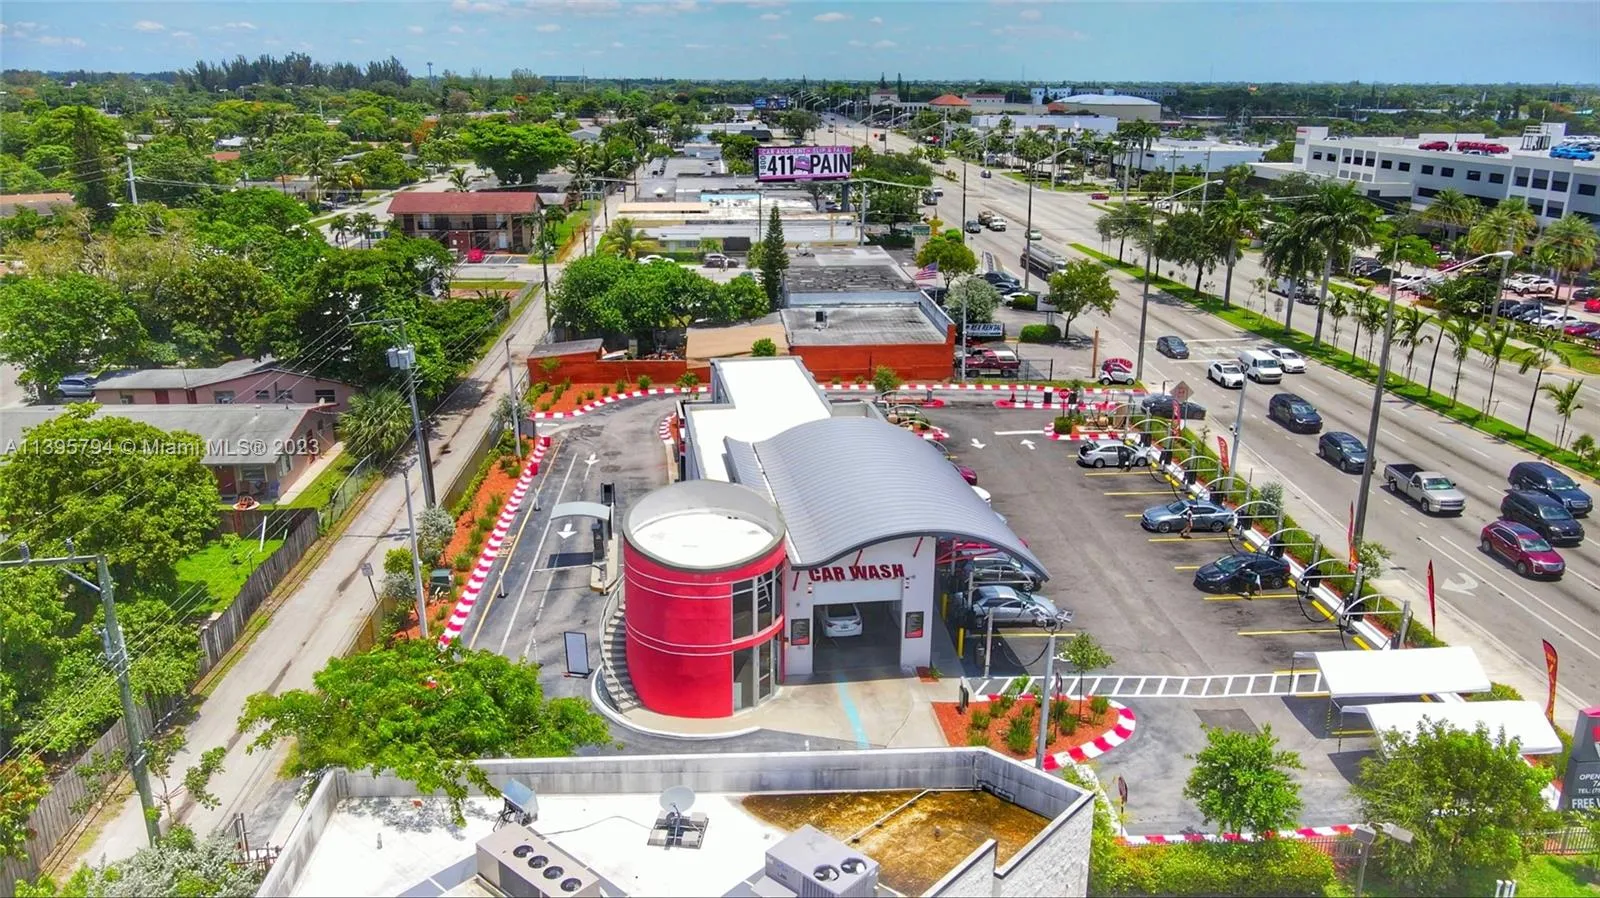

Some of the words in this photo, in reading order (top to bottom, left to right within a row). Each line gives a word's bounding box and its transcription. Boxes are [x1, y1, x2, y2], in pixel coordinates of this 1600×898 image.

[767, 155, 793, 175] 411
[810, 153, 851, 174] PAIN
[808, 566, 845, 582] CAR
[848, 563, 905, 580] WASH
